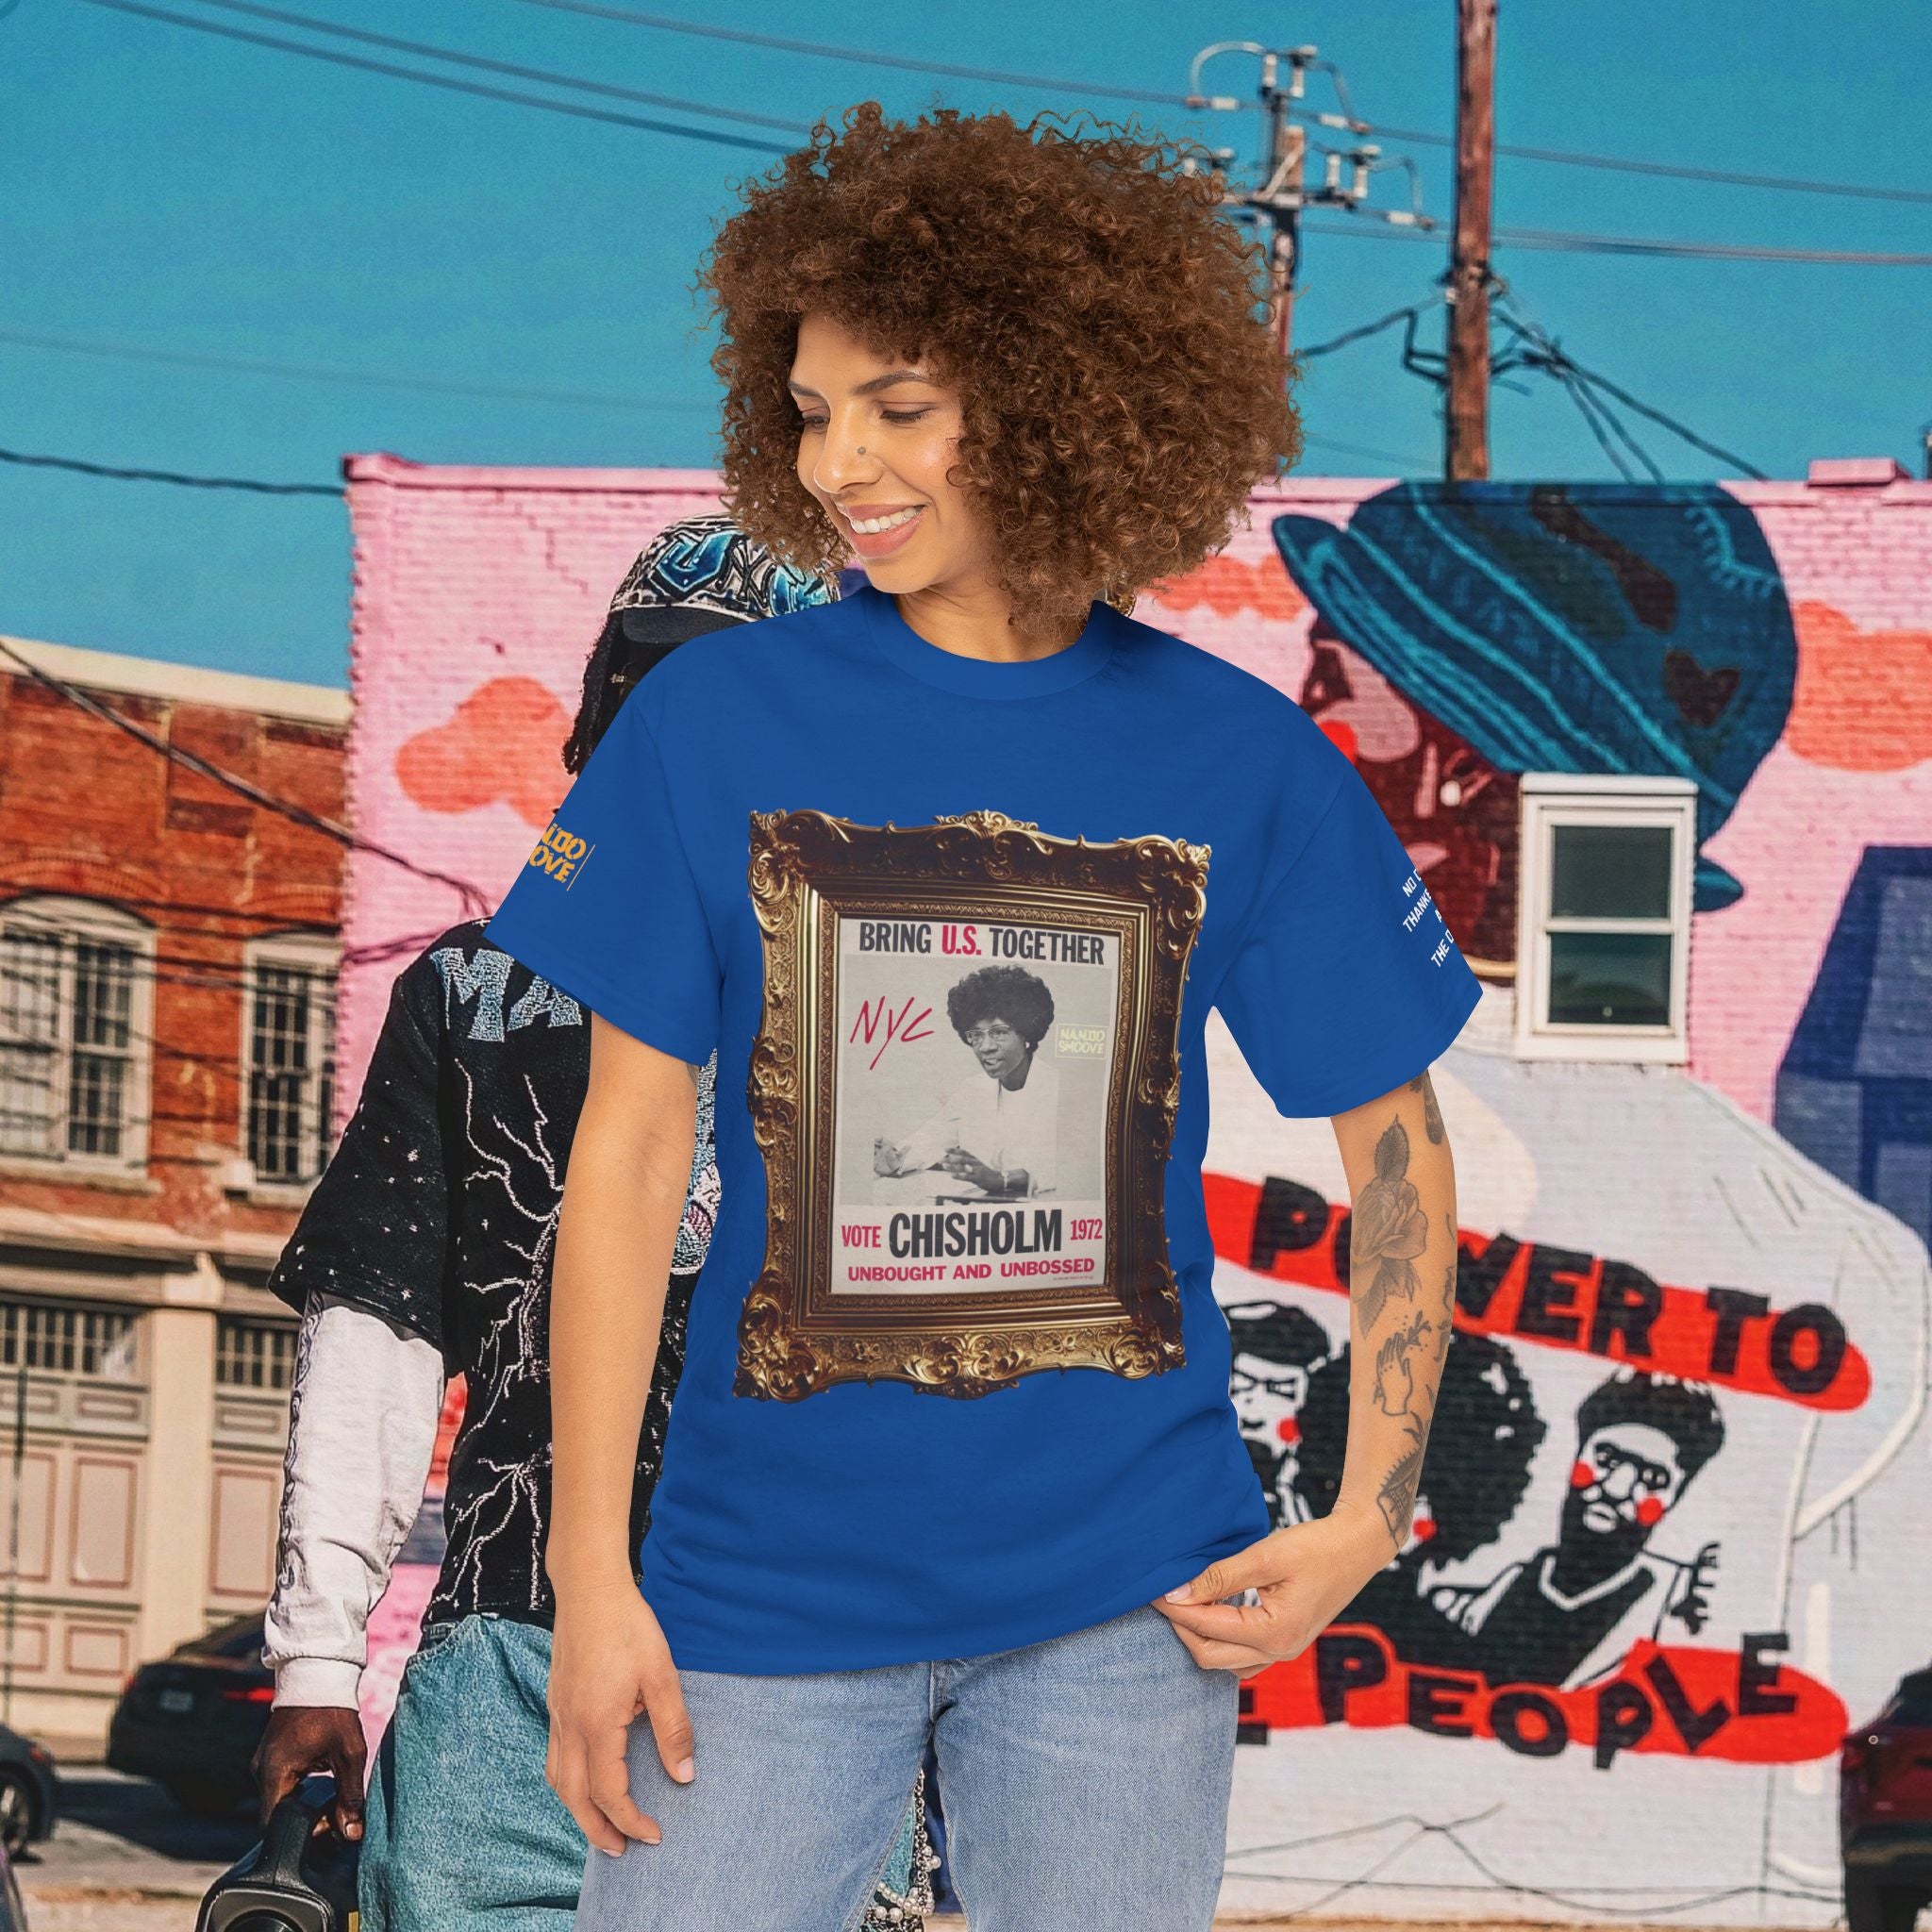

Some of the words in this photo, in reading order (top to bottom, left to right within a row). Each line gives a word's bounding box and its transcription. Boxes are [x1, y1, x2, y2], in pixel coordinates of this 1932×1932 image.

[1402, 876, 1417, 897] NO
[859, 922, 932, 954] BRING
[941, 924, 982, 956] U.S.
[989, 927, 1105, 965] TOGETHER
[1431, 939, 1449, 967] THE
[849, 995, 934, 1071] NYC
[1058, 1040, 1104, 1054] SMOOVE
[1060, 1028, 1106, 1042] NANDO
[841, 1224, 881, 1248] VOTE
[889, 1208, 1062, 1258] CHISHOLM
[1070, 1219, 1103, 1241] 1972
[848, 1265, 947, 1282] UNBOUGHT
[952, 1263, 991, 1280] AND
[1000, 1257, 1095, 1277] UNBOSSED
[1249, 1175, 1662, 1357] PWER
[1706, 1287, 1846, 1396] TO
[1316, 1632, 1798, 1771] PEOPLE
